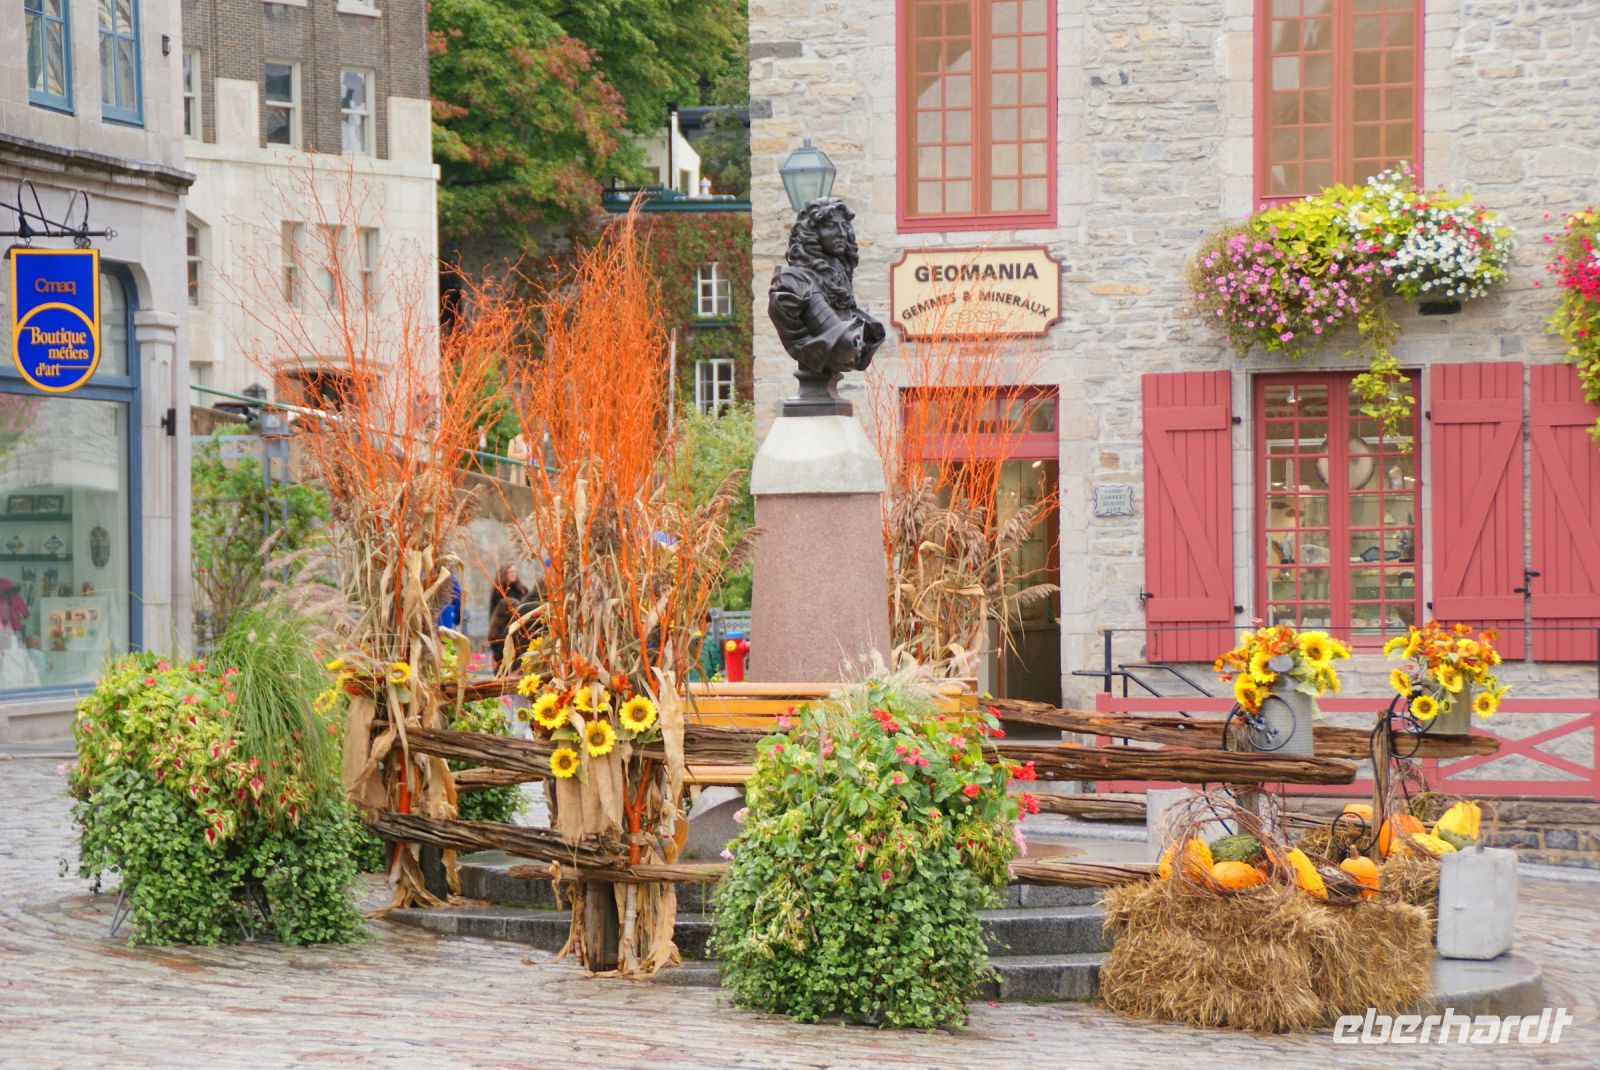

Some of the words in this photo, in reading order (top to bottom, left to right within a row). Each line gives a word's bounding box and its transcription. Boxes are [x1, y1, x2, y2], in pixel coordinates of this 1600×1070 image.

[915, 263, 1038, 282] GEOMANIA
[902, 293, 956, 320] GEMMES
[964, 291, 972, 302] &
[979, 290, 1050, 317] MINERAUX
[31, 327, 86, 346] Boutique
[48, 346, 88, 359] métiers
[35, 362, 60, 376] d'art
